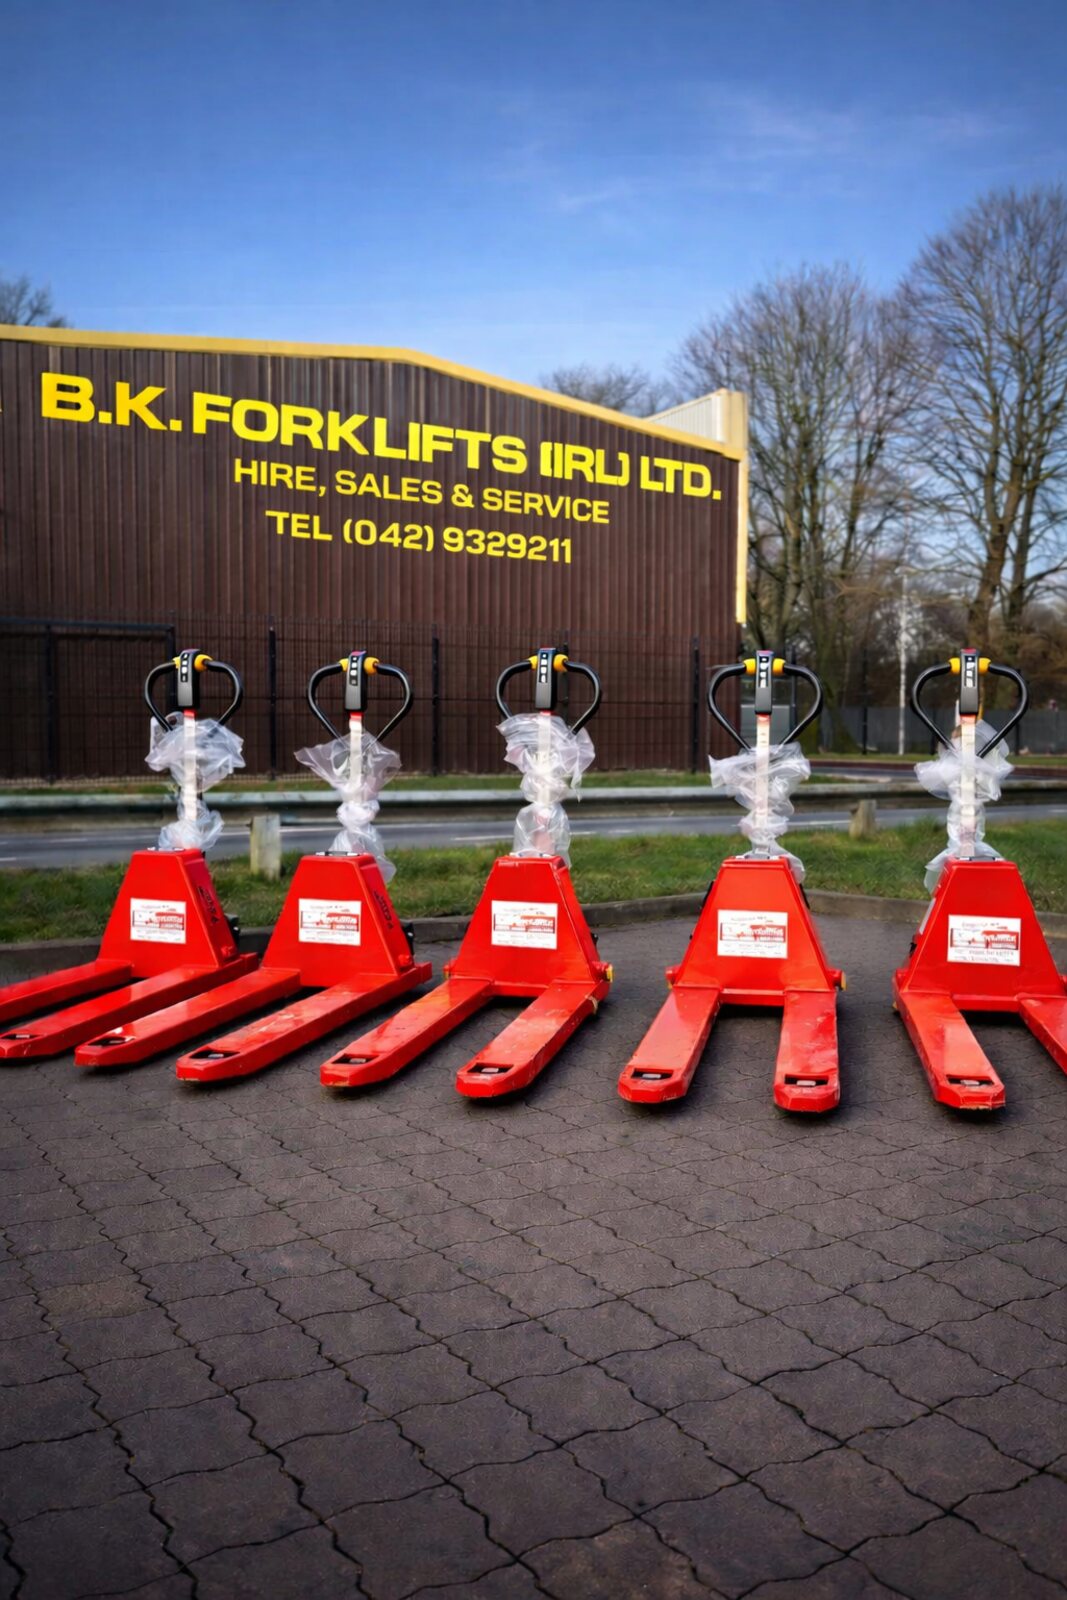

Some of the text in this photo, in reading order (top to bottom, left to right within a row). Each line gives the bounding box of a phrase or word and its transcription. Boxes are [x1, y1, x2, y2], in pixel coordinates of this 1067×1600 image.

[41, 372, 183, 433] B.K.
[192, 391, 528, 475] FORKLIFTS
[639, 456, 722, 501] LTD.
[233, 458, 610, 525] HIRE, SALES & SERVICE
[264, 509, 572, 565] TEL (042) 9329211
